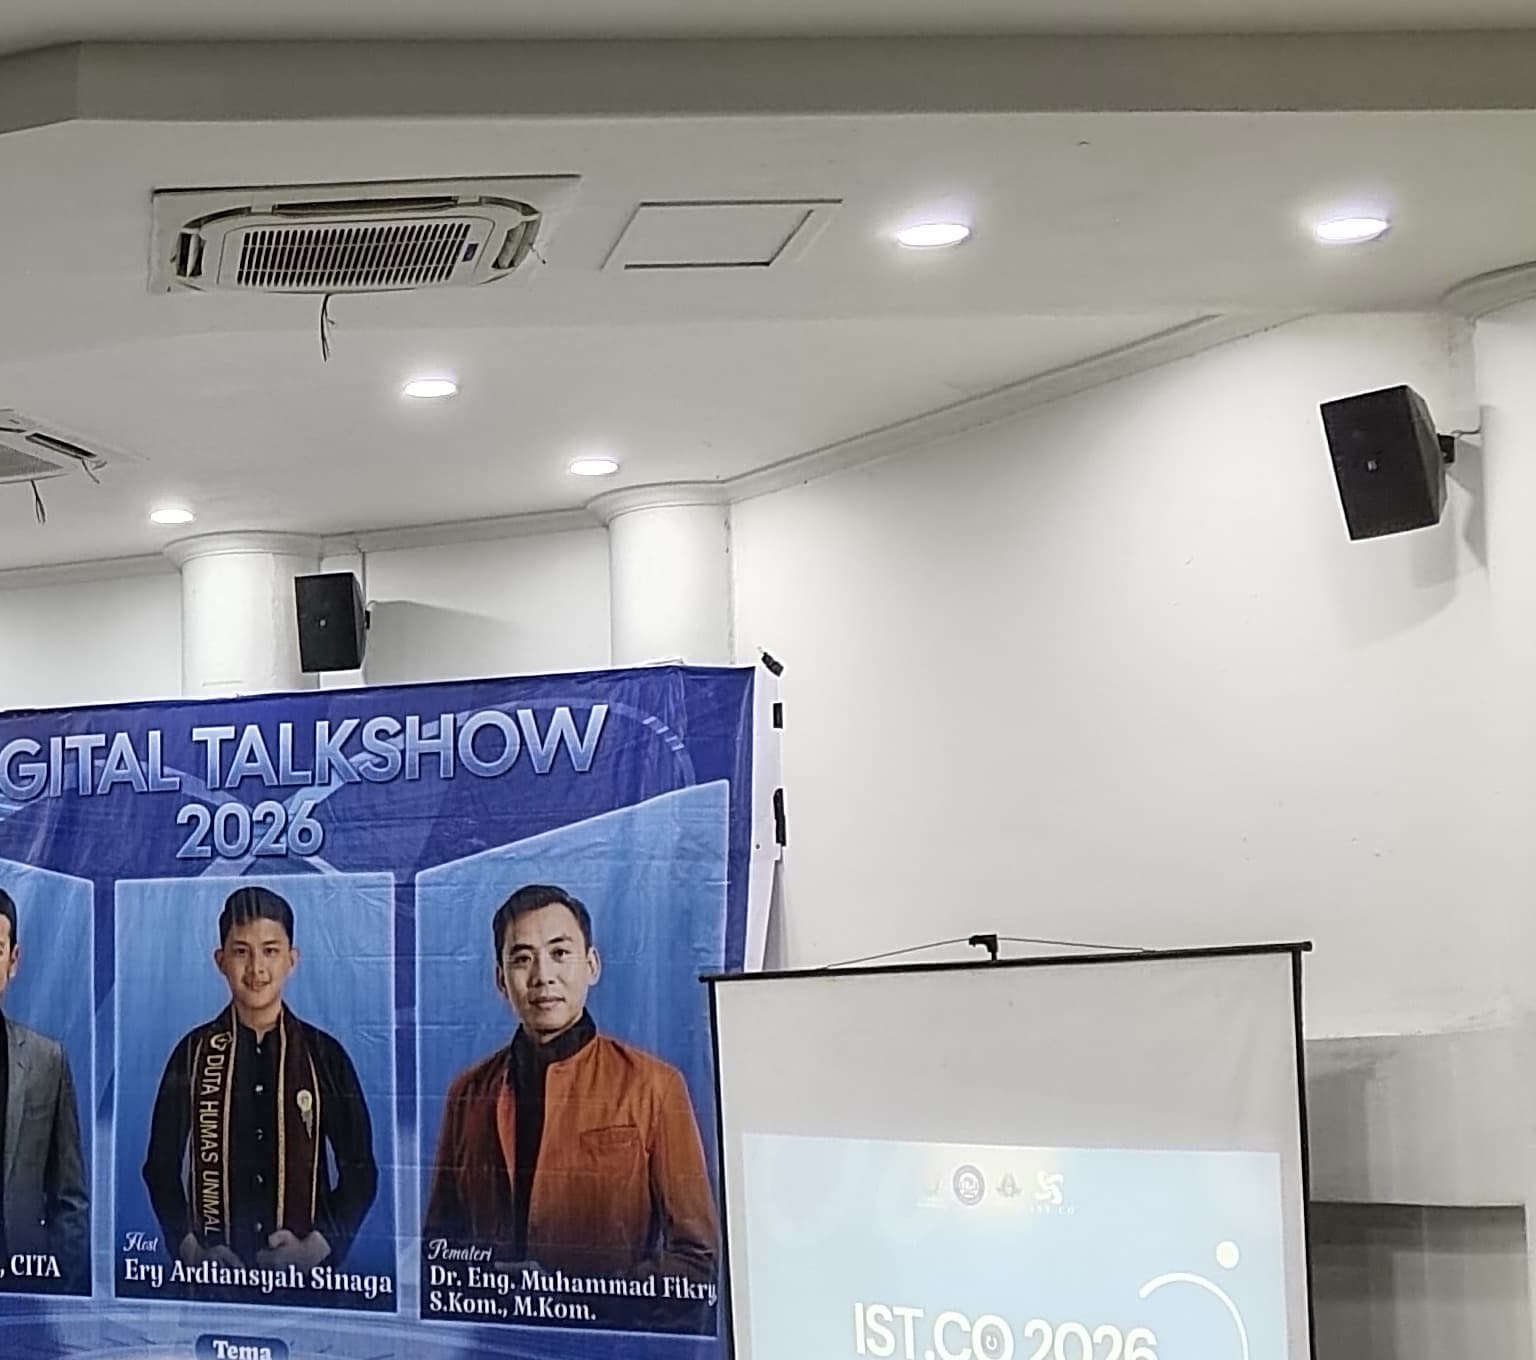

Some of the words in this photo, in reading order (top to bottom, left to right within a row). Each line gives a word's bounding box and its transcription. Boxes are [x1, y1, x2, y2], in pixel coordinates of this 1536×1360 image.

[192, 703, 610, 790] TALKSHOW
[176, 799, 325, 860] 2026
[201, 1054, 225, 1096] DUTA
[199, 1100, 220, 1164] HUMAS
[202, 1171, 222, 1236] UNIMAL
[123, 1231, 158, 1252] Host
[427, 1238, 493, 1262] Pemateri
[10, 1254, 61, 1278] CITA
[124, 1257, 164, 1288] Ery
[169, 1259, 306, 1294] Ardiansyah
[311, 1266, 394, 1300] Sinaga
[430, 1265, 462, 1287] Dr.
[468, 1266, 516, 1296] Eng.
[521, 1269, 657, 1298] Muhammad
[662, 1276, 718, 1307] Fikry
[429, 1291, 508, 1318] S.Kom.,
[514, 1295, 597, 1321] M.Kom.
